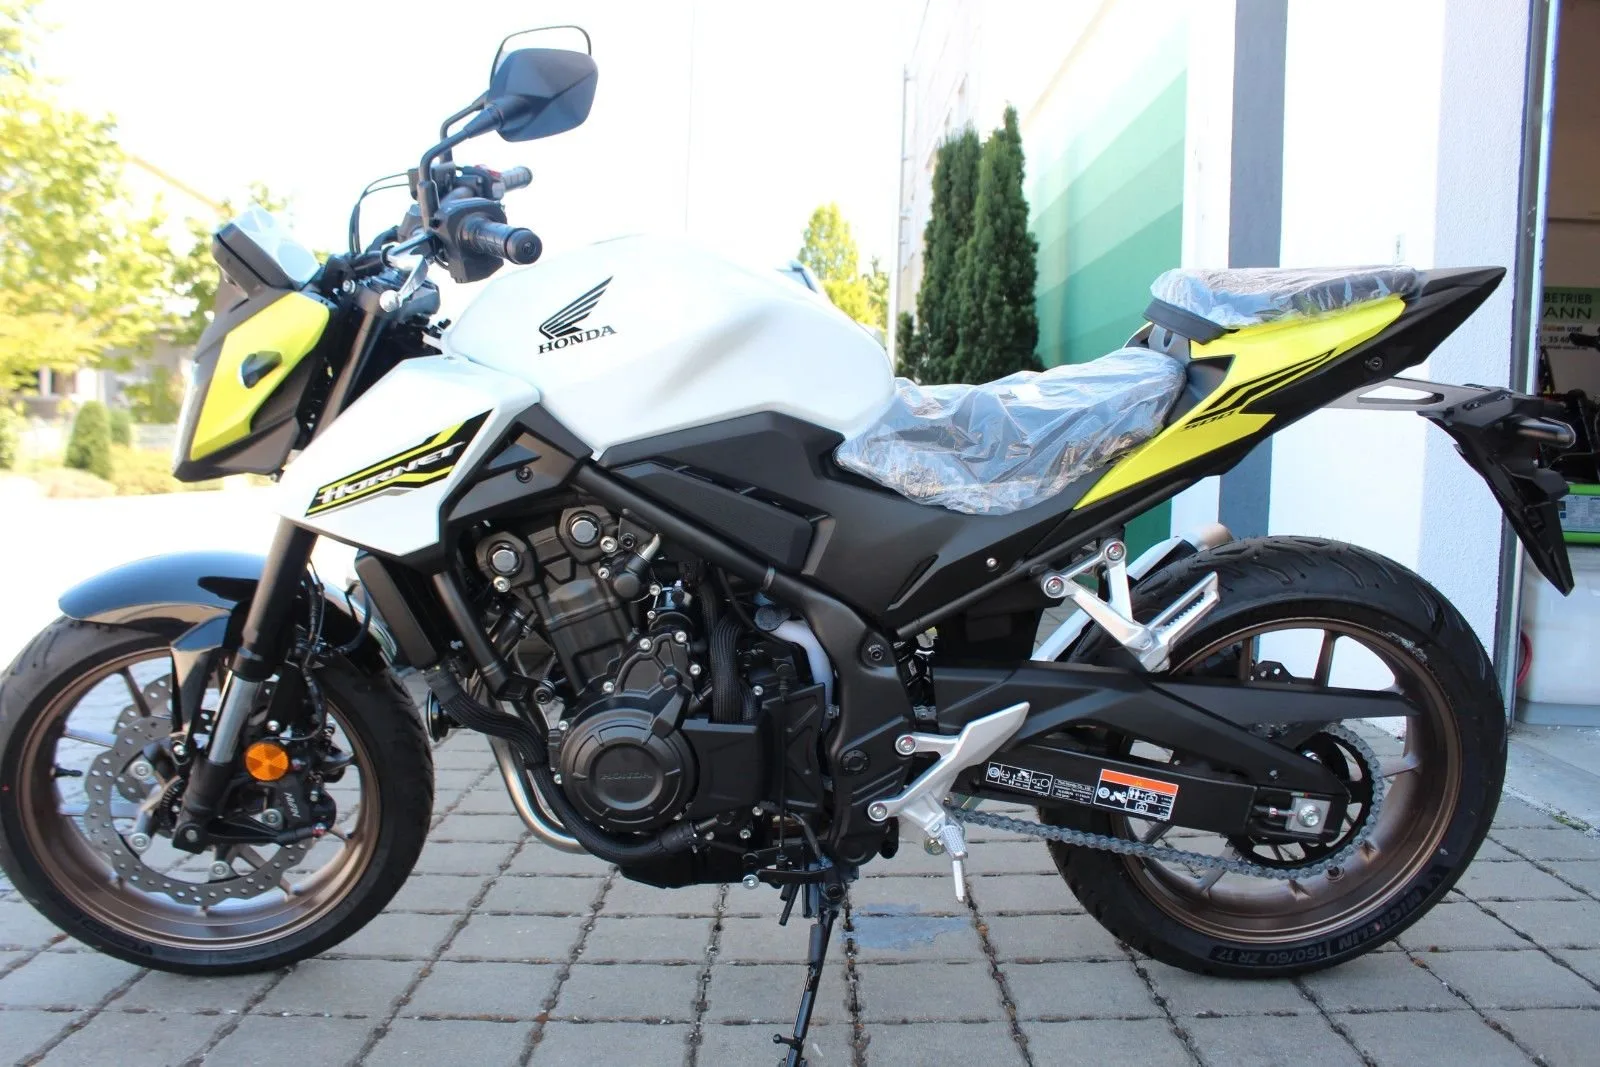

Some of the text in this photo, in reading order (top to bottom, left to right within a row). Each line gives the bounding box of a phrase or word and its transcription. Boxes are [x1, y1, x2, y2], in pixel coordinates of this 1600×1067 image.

[538, 325, 618, 354] HONDA
[315, 441, 466, 505] HORNET
[1338, 887, 1423, 951] MICHELIN
[1265, 943, 1324, 966] 160/60
